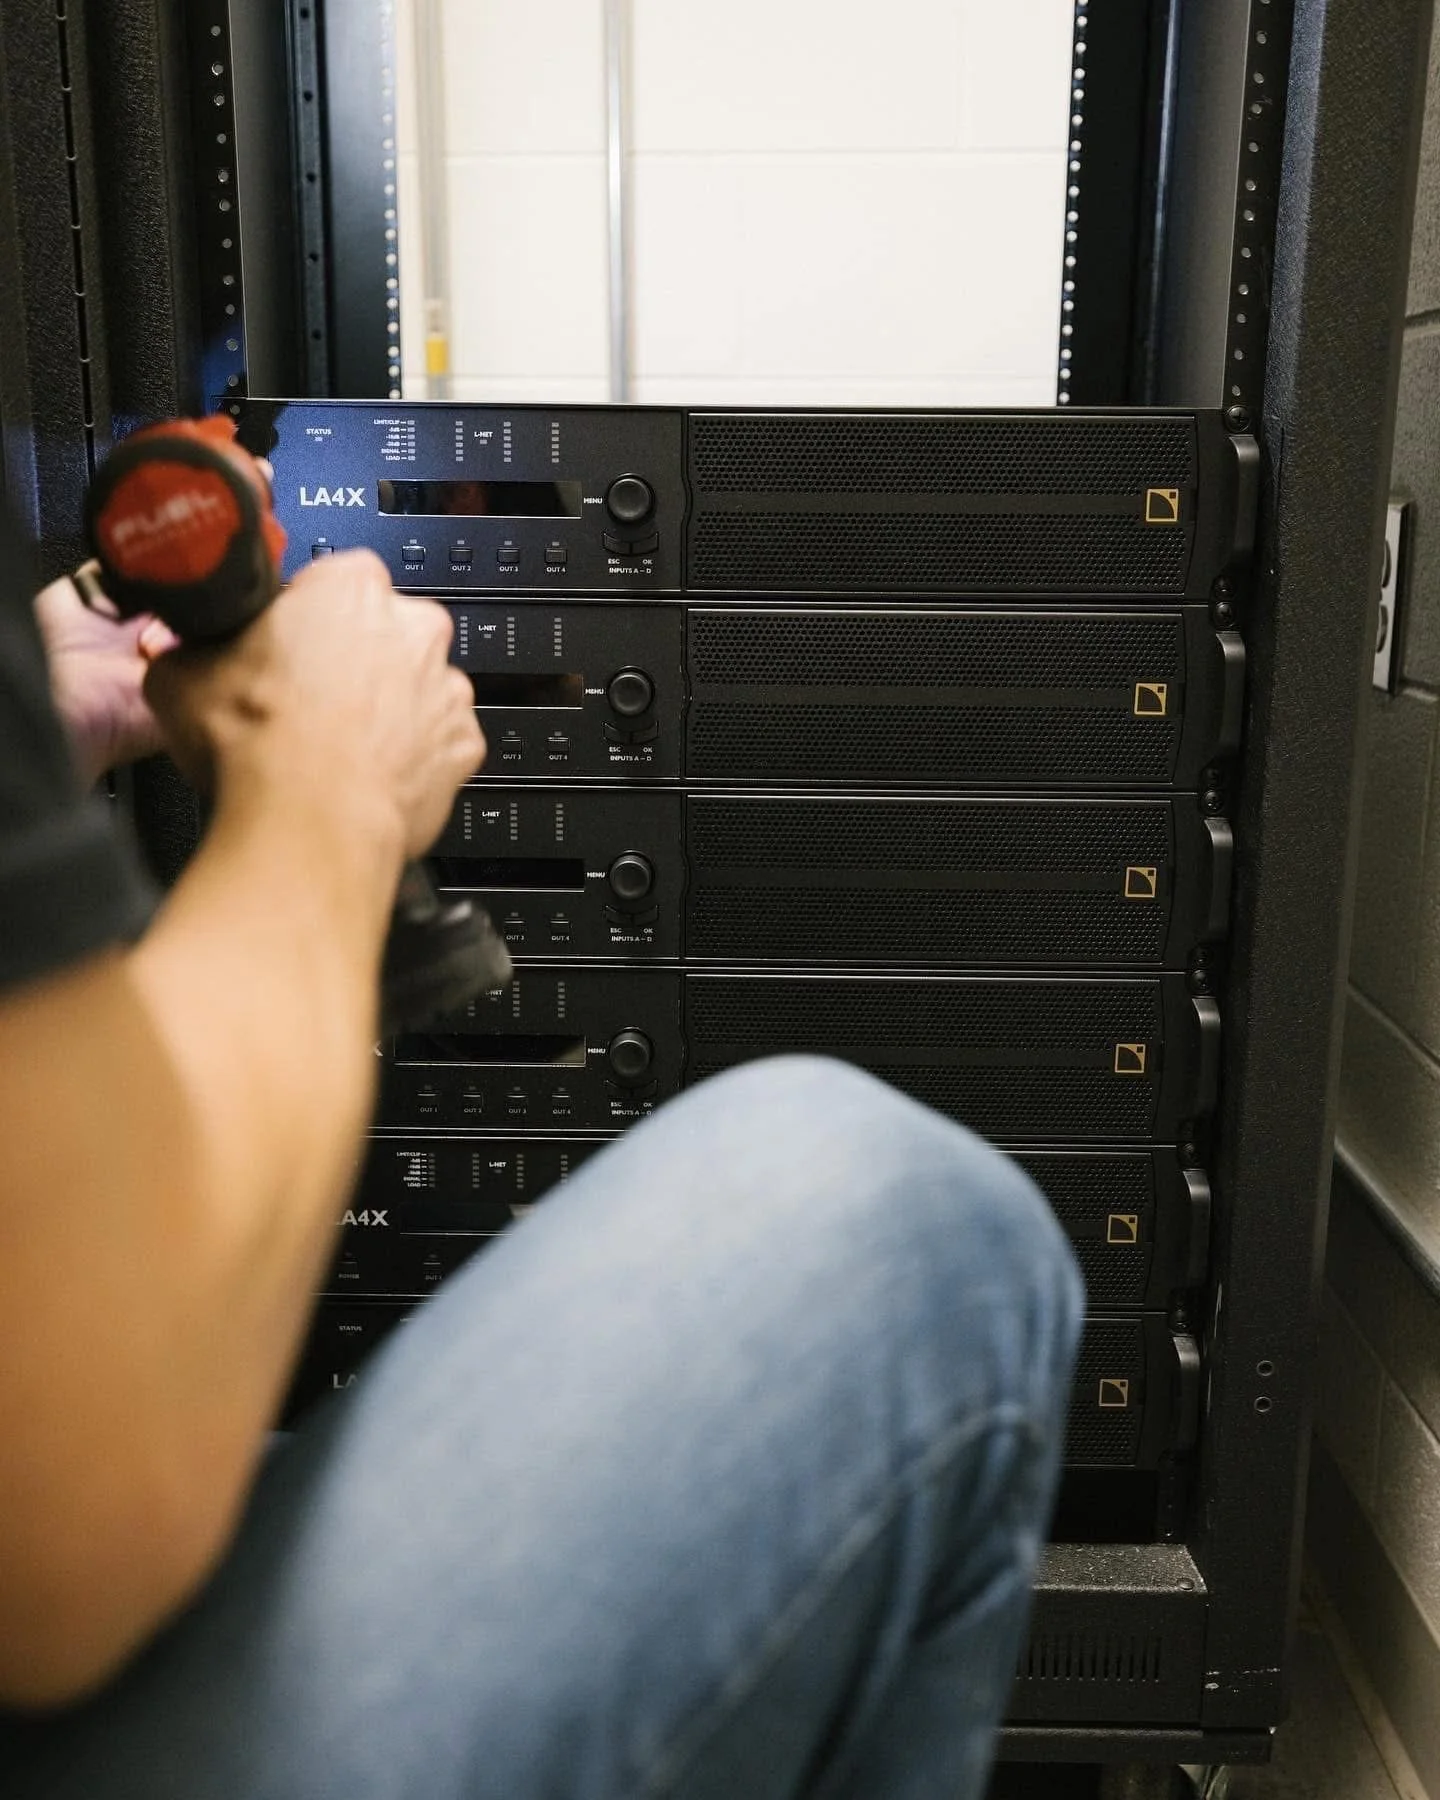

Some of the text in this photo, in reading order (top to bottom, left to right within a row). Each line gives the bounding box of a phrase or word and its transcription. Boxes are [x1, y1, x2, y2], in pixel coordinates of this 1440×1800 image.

[306, 428, 331, 436] STATUS
[300, 487, 365, 506] LA4X
[336, 1209, 390, 1226] A4X
